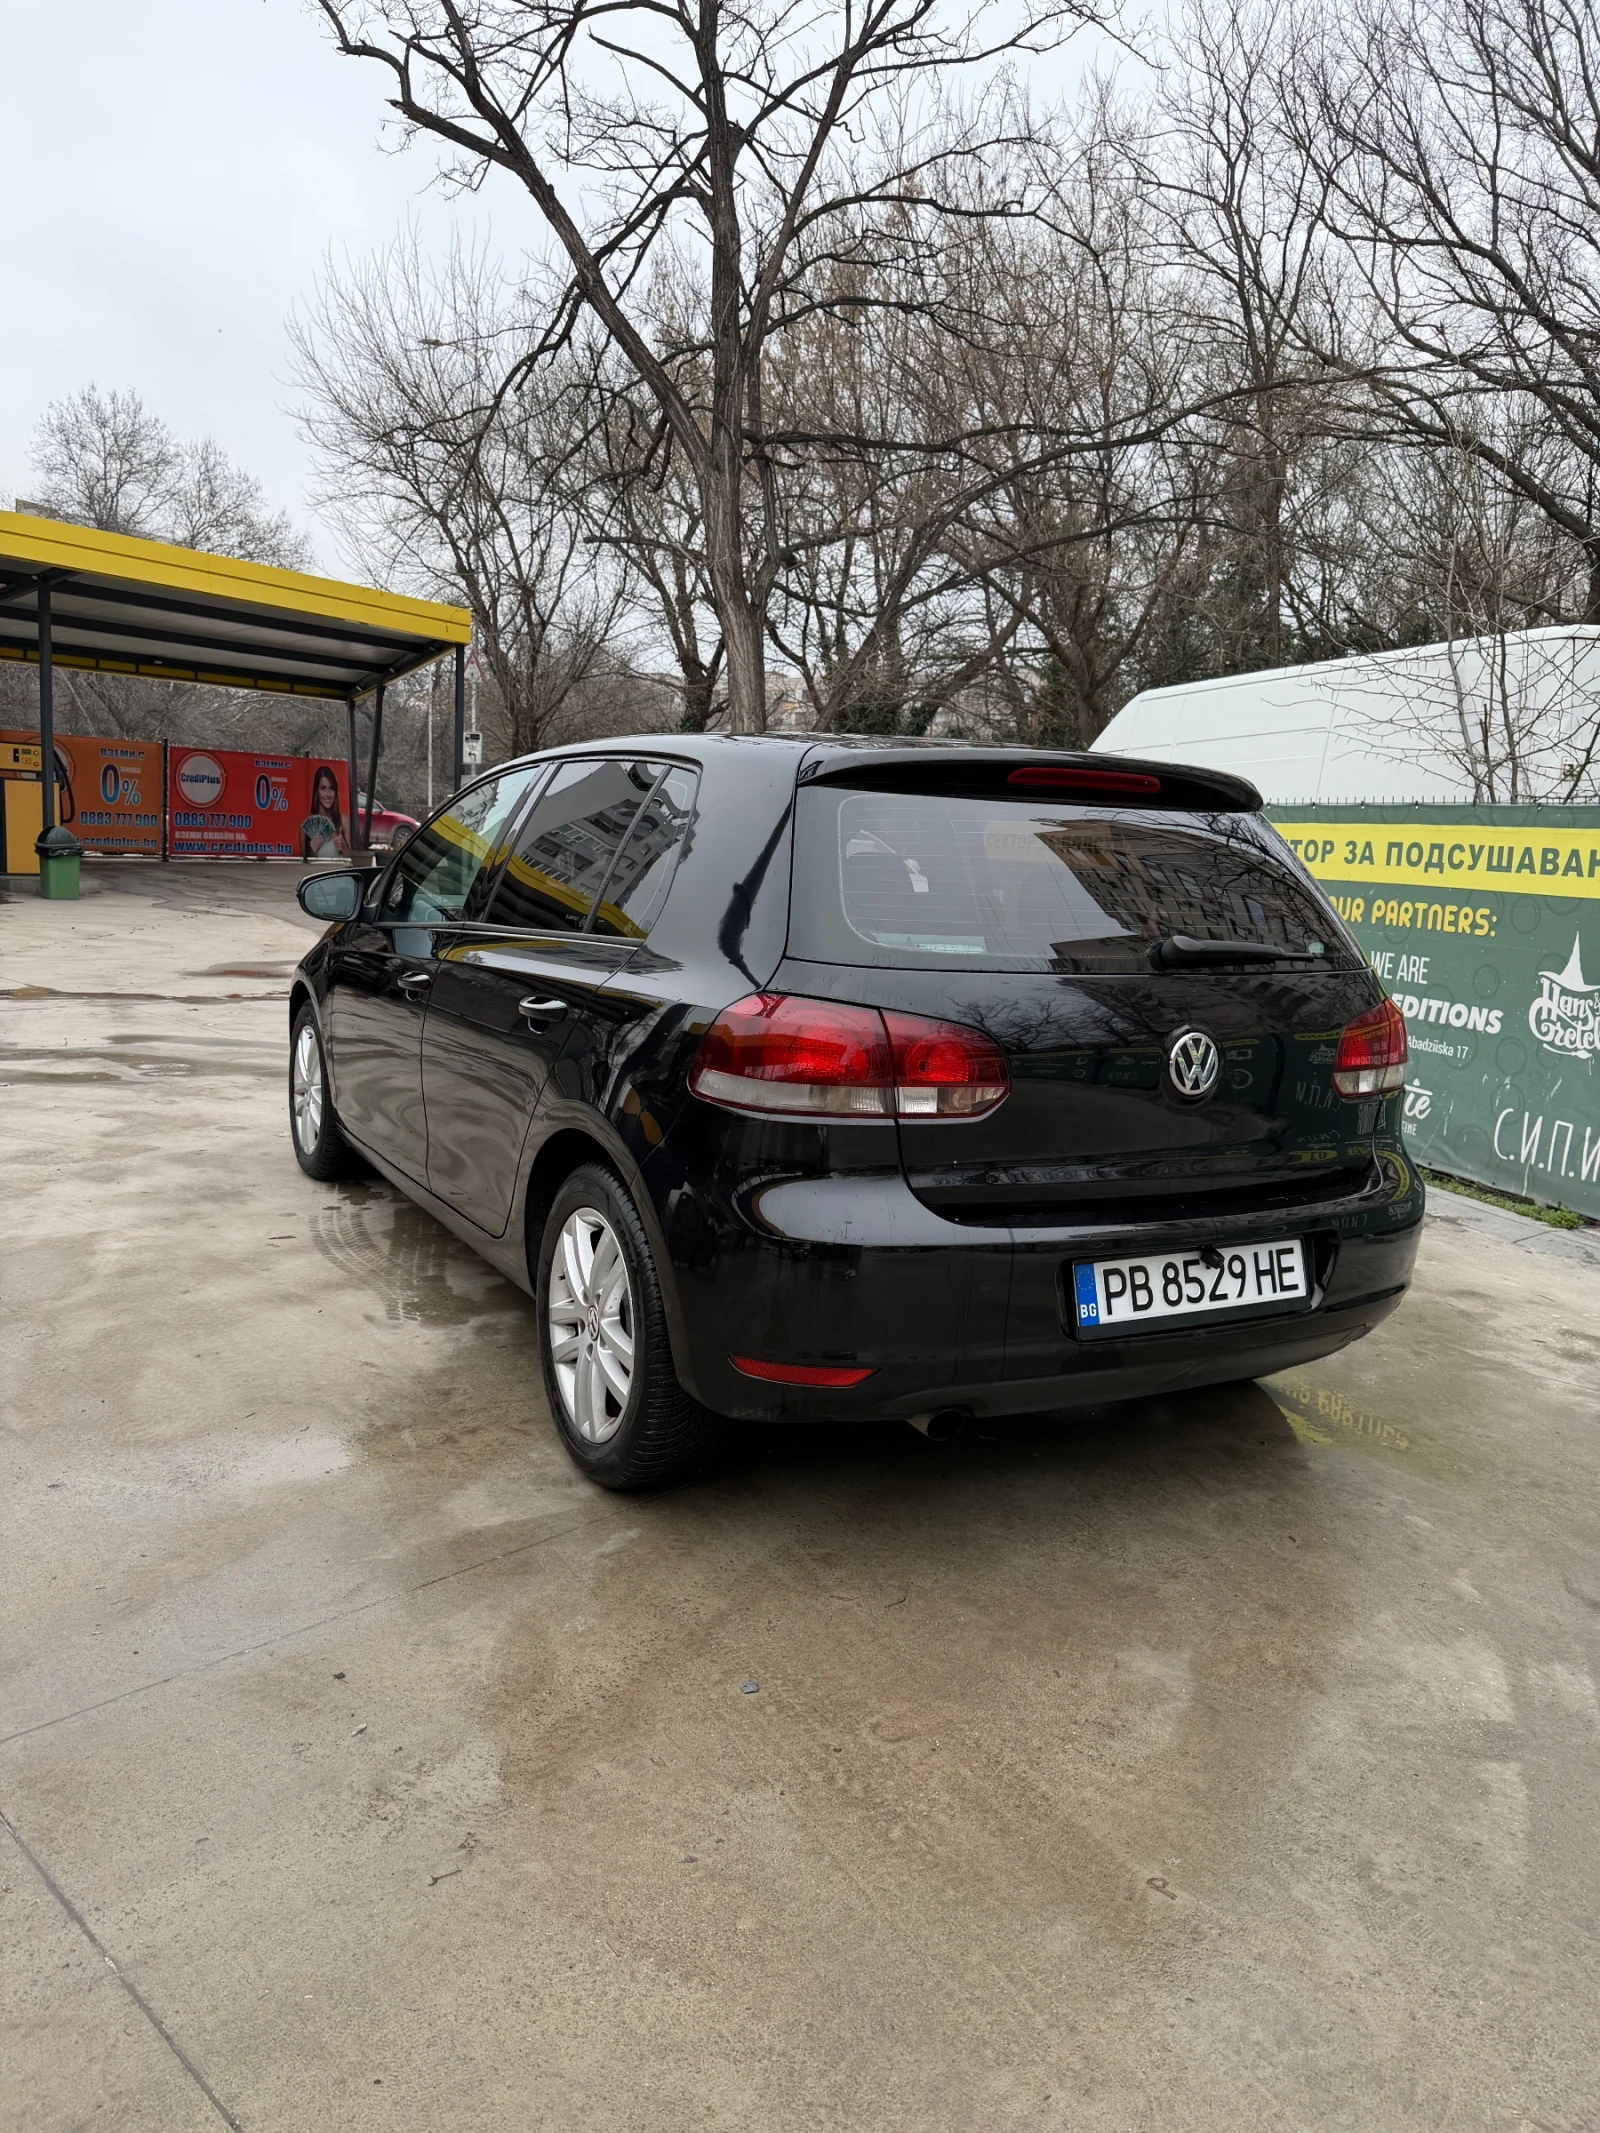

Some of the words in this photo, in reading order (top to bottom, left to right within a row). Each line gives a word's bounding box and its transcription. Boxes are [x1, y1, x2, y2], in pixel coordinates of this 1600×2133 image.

[100, 748, 135, 759] ВЗЕМИ
[101, 763, 142, 806] 0%
[181, 773, 221, 785] CrediPlus
[255, 773, 288, 811] 0%
[80, 811, 112, 826] 0883
[114, 812, 132, 827] 777
[135, 814, 158, 828] 900
[174, 811, 206, 827] 0883
[208, 813, 227, 828] 777
[228, 814, 252, 829] 900
[78, 837, 157, 848] .crediplus.bg
[173, 841, 293, 855] www.crediplus.bg
[1288, 838, 1335, 863] ТОР
[1344, 841, 1375, 866] ЗА
[1371, 899, 1498, 938] PARTNERS:
[1370, 950, 1395, 980] WE
[1397, 955, 1430, 985] ARE
[1540, 977, 1594, 1026] Hans
[1457, 1046, 1468, 1060] 17
[1102, 1265, 1154, 1315] PB
[1161, 1254, 1247, 1307] 8529
[1253, 1247, 1299, 1296] HE
[1080, 1304, 1097, 1319] BG
